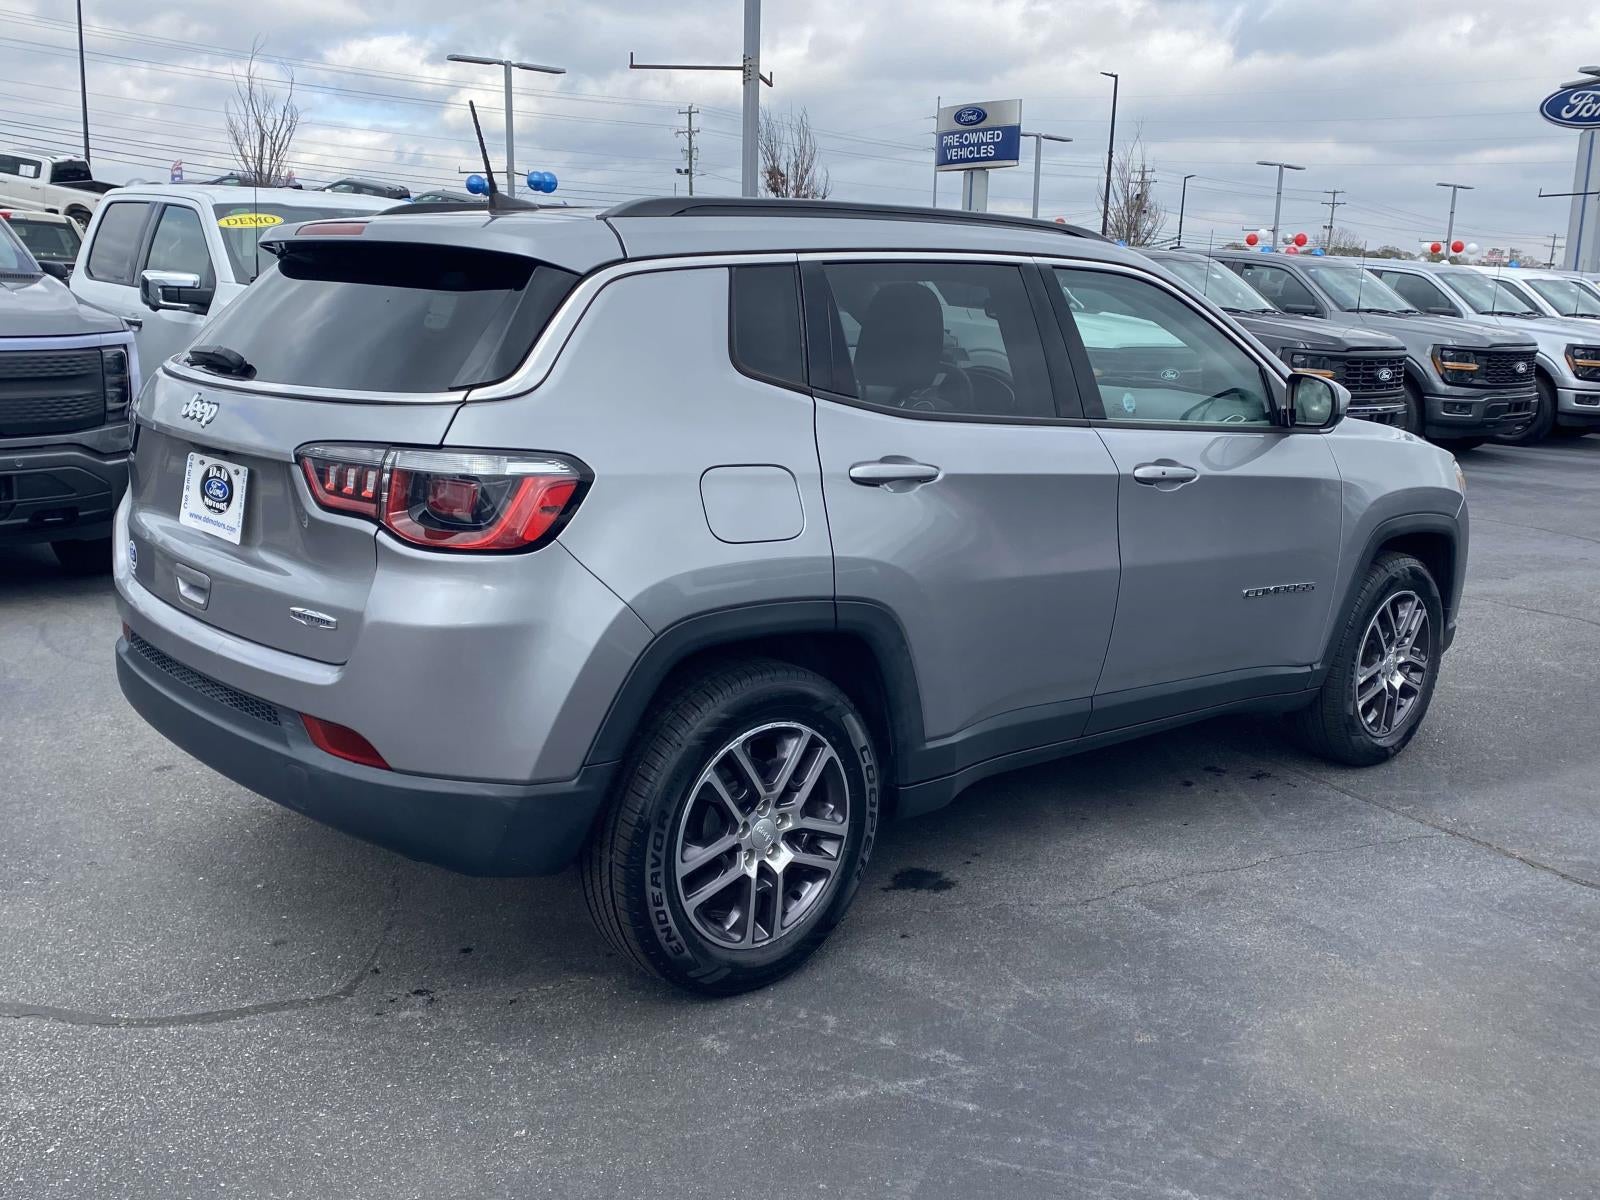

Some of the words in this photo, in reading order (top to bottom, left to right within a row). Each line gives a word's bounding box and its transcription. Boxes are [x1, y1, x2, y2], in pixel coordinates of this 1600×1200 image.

[1561, 91, 1600, 119] For
[960, 110, 978, 122] Ford
[943, 130, 1003, 147] PRE-OWNED
[946, 145, 995, 160] VEHICLES
[225, 216, 276, 226] DEMO
[181, 392, 219, 428] Jeep
[208, 466, 229, 482] D&D
[208, 480, 225, 498] Ford
[204, 495, 228, 511] MOTORS
[188, 511, 237, 533] www.ddmotors.com
[1243, 582, 1316, 599] COMPASS
[856, 745, 879, 881] COOPER
[650, 808, 686, 956] ENDEAVOR
